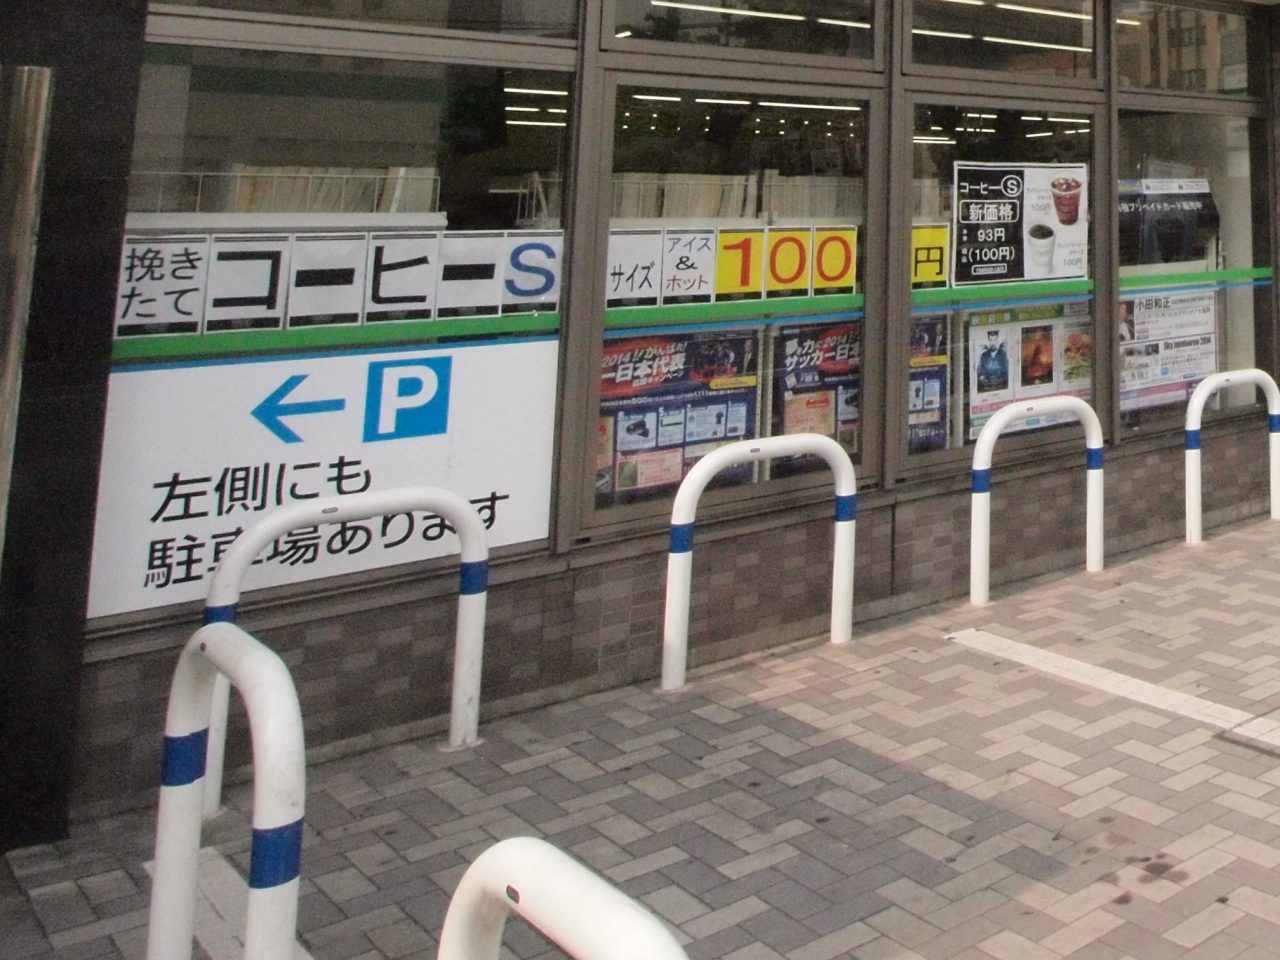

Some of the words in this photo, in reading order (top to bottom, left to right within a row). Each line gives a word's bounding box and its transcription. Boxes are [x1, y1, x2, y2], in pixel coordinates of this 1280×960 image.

[969, 203, 1013, 222] 新価格
[667, 236, 713, 253] アイス
[978, 228, 1005, 242] 93円
[125, 246, 203, 283] 挽き
[675, 255, 698, 271] &
[722, 235, 853, 288] 100
[914, 246, 944, 277] 円
[969, 246, 1015, 263] (100円)
[610, 259, 655, 292] サイズ
[665, 274, 710, 292] ホット
[121, 286, 200, 319] たて
[1135, 297, 1171, 311] 小田和正
[378, 365, 439, 435] P
[150, 456, 373, 525] 左側にも
